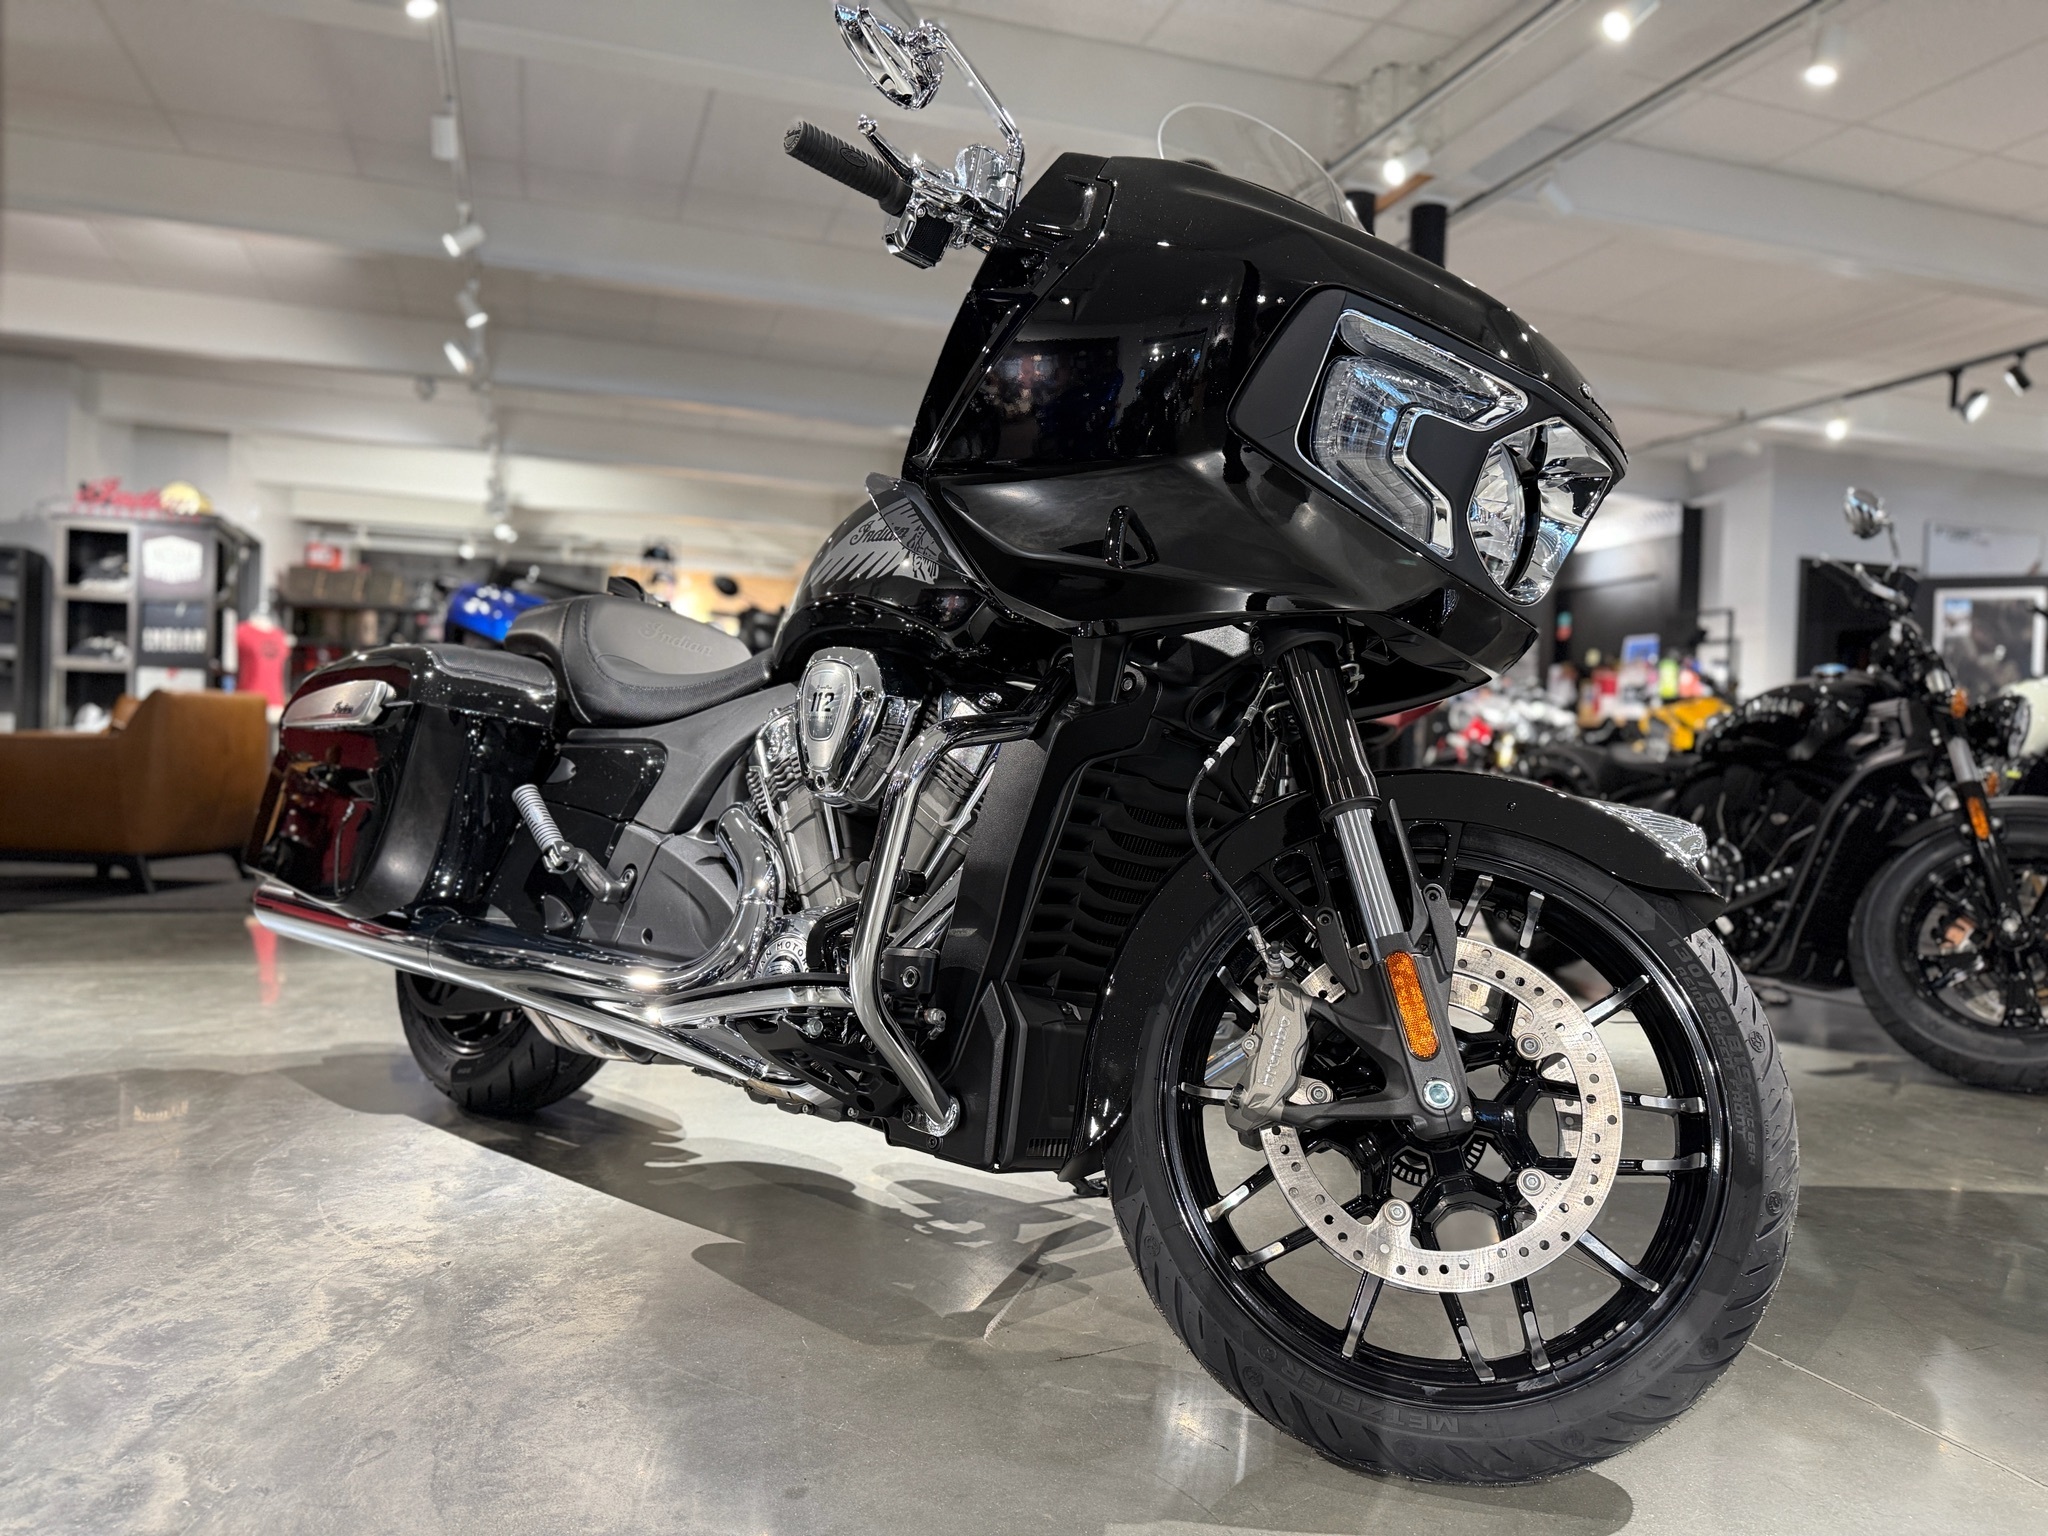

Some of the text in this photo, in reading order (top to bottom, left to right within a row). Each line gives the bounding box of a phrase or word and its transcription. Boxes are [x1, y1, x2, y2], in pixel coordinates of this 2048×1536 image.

[849, 520, 910, 546] Indian
[638, 621, 712, 656] Indian
[810, 692, 835, 713] 112
[1667, 938, 1733, 1027] 130/60
[1258, 1015, 1291, 1088] brembo
[1675, 966, 1746, 1136] REINFORCED FRONT
[1281, 1358, 1459, 1433] METZELER
